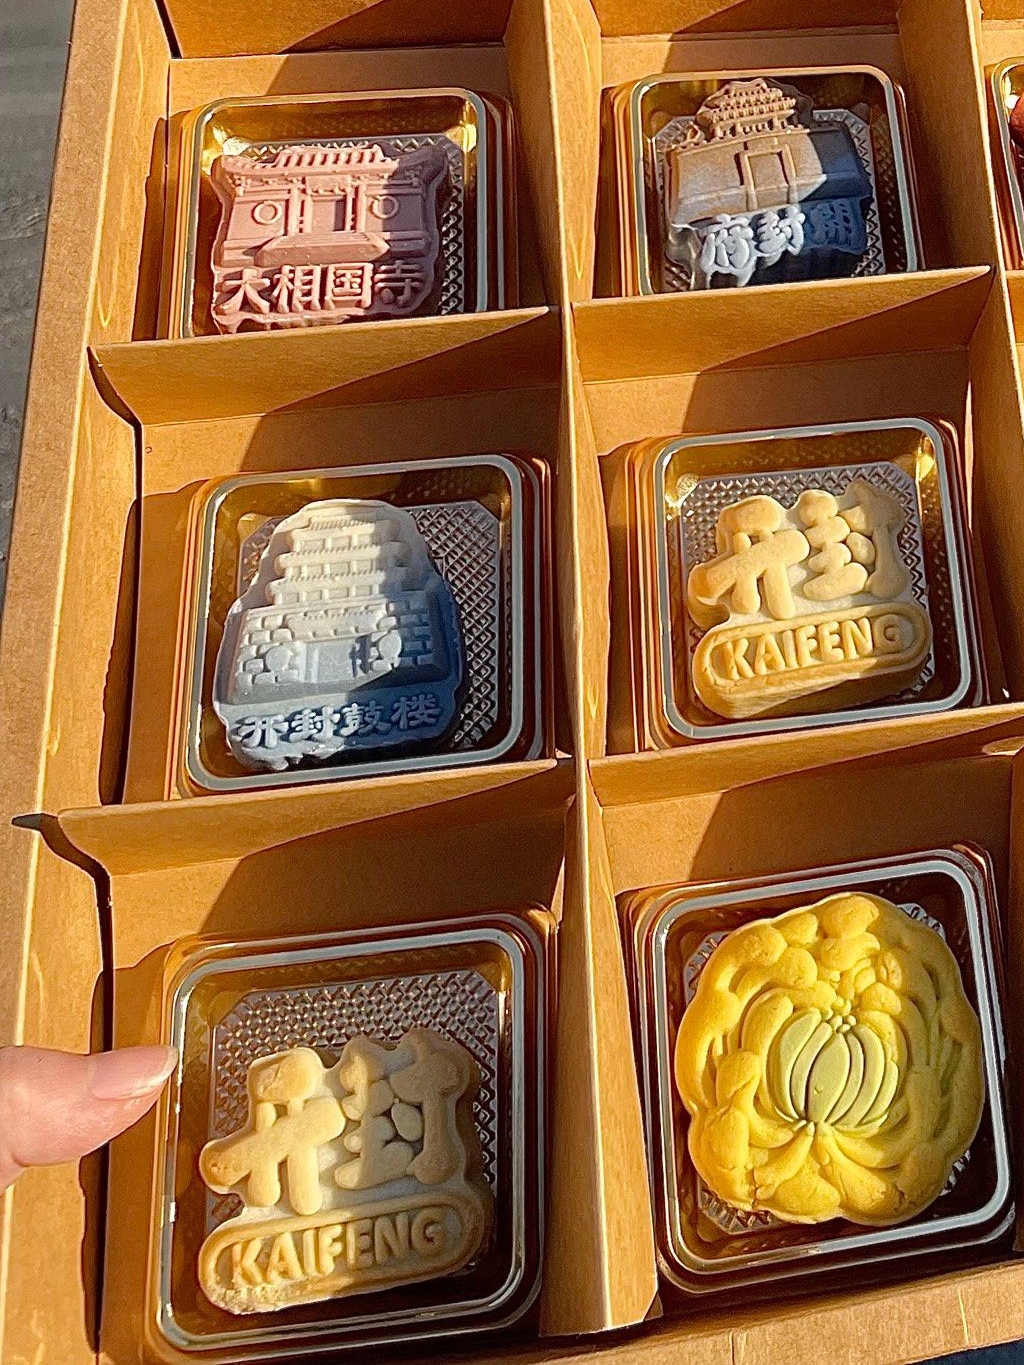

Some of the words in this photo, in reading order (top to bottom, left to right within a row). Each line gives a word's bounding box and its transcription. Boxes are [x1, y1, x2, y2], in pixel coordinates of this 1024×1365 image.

[215, 259, 426, 316] 大相国寺
[724, 614, 900, 681] KAIFENG
[236, 692, 441, 749] 开封鼓楼
[230, 1208, 448, 1285] KAIFENG
